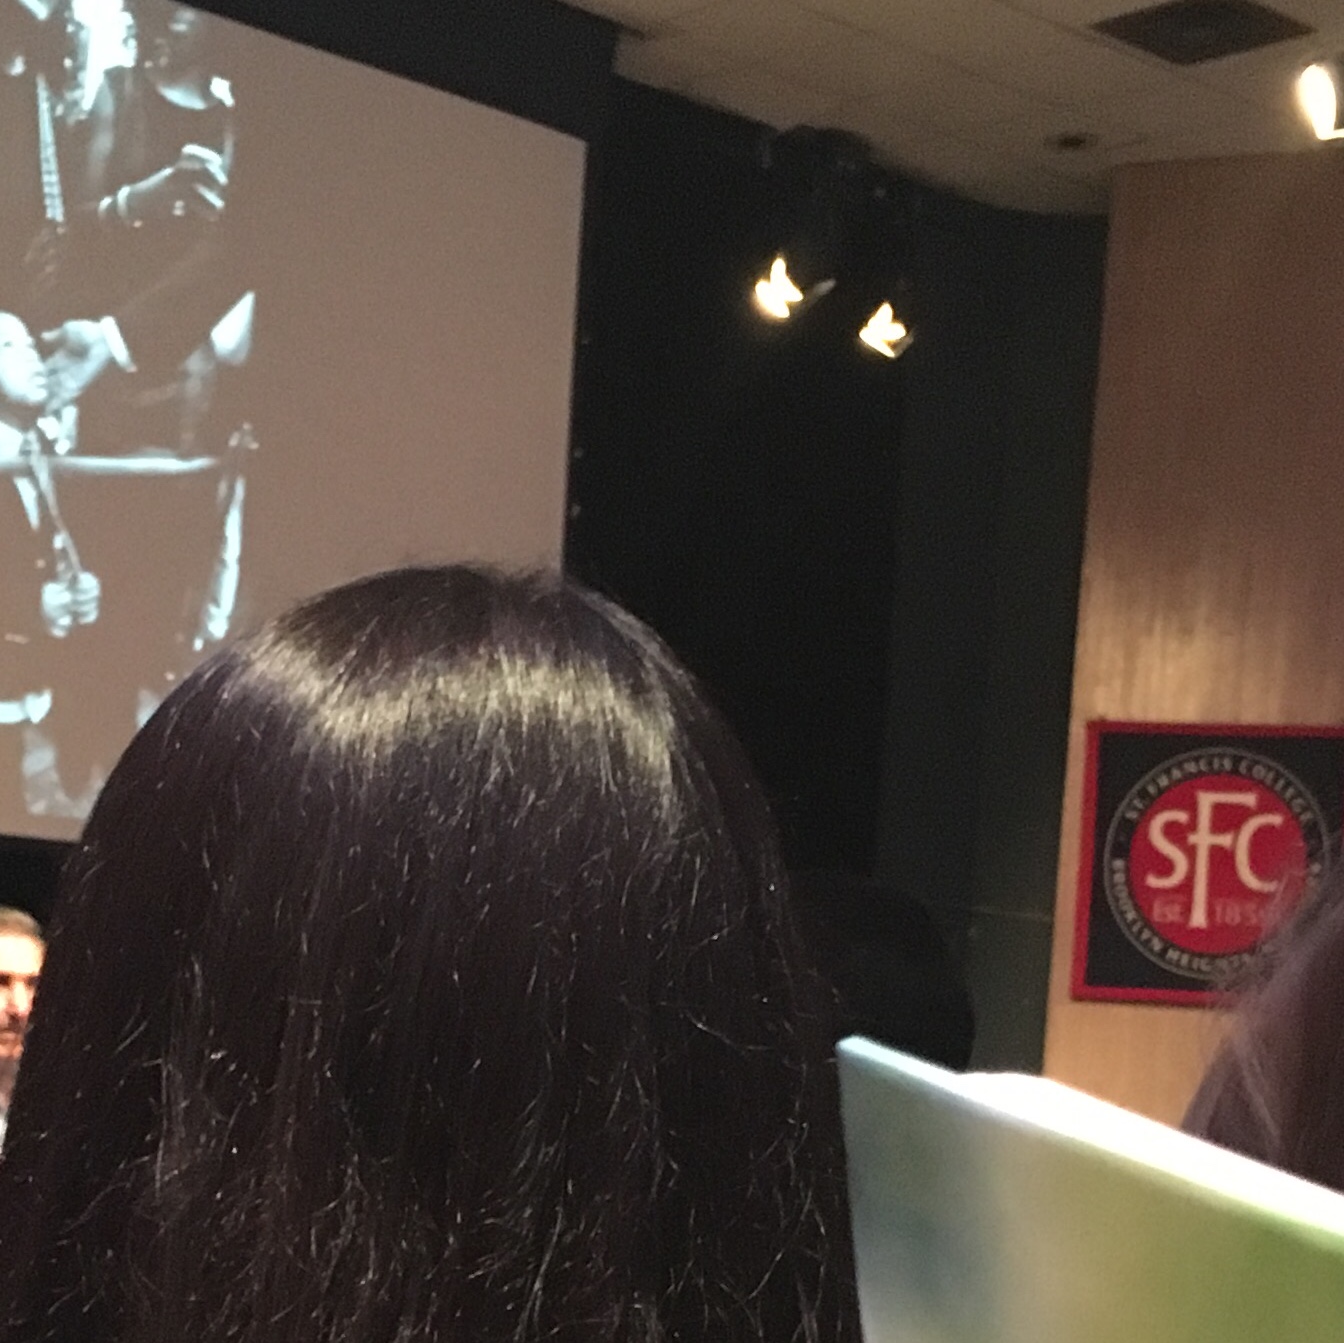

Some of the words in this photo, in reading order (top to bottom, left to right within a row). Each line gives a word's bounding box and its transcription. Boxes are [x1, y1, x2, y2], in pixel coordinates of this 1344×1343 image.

[1146, 755, 1233, 796] FRANCIS
[1238, 757, 1314, 822] COLLEGE
[1111, 857, 1162, 953] BROOKLYN
[1144, 789, 1285, 929] SFC
